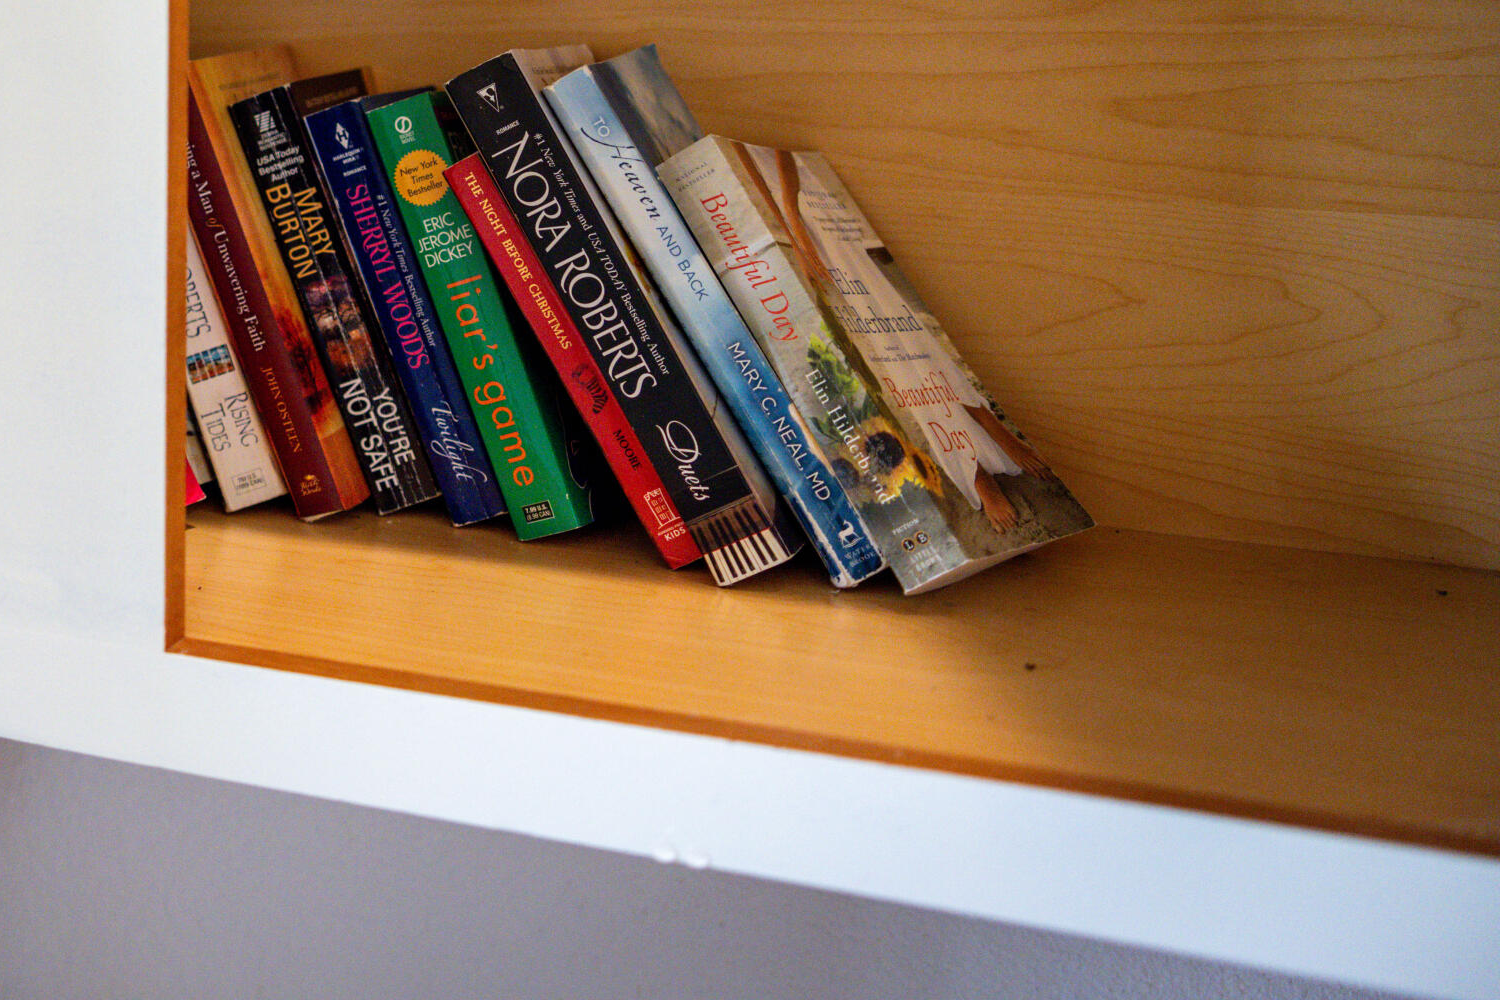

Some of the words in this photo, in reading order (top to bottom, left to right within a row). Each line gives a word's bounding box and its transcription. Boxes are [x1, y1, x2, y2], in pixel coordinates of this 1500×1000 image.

[257, 153, 275, 167] USA
[274, 146, 300, 161] Today
[593, 115, 611, 138] TO
[258, 154, 304, 176] Bestselling
[271, 167, 299, 183] Author
[400, 166, 418, 178] New
[419, 158, 439, 170] York
[407, 180, 445, 199] Bestseller
[411, 172, 434, 185] Times
[580, 127, 661, 222] Heaven
[266, 183, 317, 279] BURTON
[294, 187, 336, 255] MARY
[418, 223, 473, 254] JEROME
[422, 212, 455, 233] ERIC
[196, 180, 214, 215] Man
[214, 229, 250, 315] Unwavering
[244, 314, 267, 352] Faith
[346, 183, 396, 283] SHERRYL
[383, 283, 430, 369] WOODS
[425, 241, 473, 269] DICKEY
[463, 171, 485, 199] THE
[479, 199, 507, 237] NIGHT
[501, 238, 533, 283] BEFORE
[528, 283, 573, 351] CHRISTMAS
[491, 130, 571, 253] NORA
[554, 248, 658, 400] ROBERTS
[533, 133, 546, 146] #1
[540, 147, 556, 169] New
[552, 169, 570, 190] York
[563, 189, 582, 213] Times
[576, 213, 590, 231] and
[587, 231, 606, 255] USA
[599, 254, 626, 293] TODAY
[621, 292, 650, 342] Bestselling
[647, 342, 671, 376] Author
[656, 225, 682, 258] AND
[677, 258, 709, 302] BACK
[699, 191, 777, 290] Beautiful
[760, 290, 798, 343] Day
[828, 267, 870, 296] Elin
[405, 274, 425, 318] Bestselling
[420, 318, 436, 347] Author
[261, 366, 283, 400] JOHN
[277, 402, 301, 453] OSTEEN
[447, 274, 500, 371] liar's
[474, 380, 534, 488] game
[805, 368, 830, 406] Elin
[882, 370, 960, 418] Beautiful
[201, 403, 231, 453] TIDES
[224, 391, 258, 448] RISING
[339, 377, 377, 429] NOT
[361, 433, 399, 493] SAFE
[371, 387, 416, 466] YOU'RE
[431, 400, 488, 483] Twilight
[611, 429, 643, 472] MOORE
[726, 341, 768, 392] MARY
[761, 396, 778, 416] C.
[772, 417, 804, 471] NEAL,
[806, 471, 831, 501] MD
[927, 421, 978, 461] Day
[656, 420, 710, 501] Duets
[664, 526, 686, 541] KIDS
